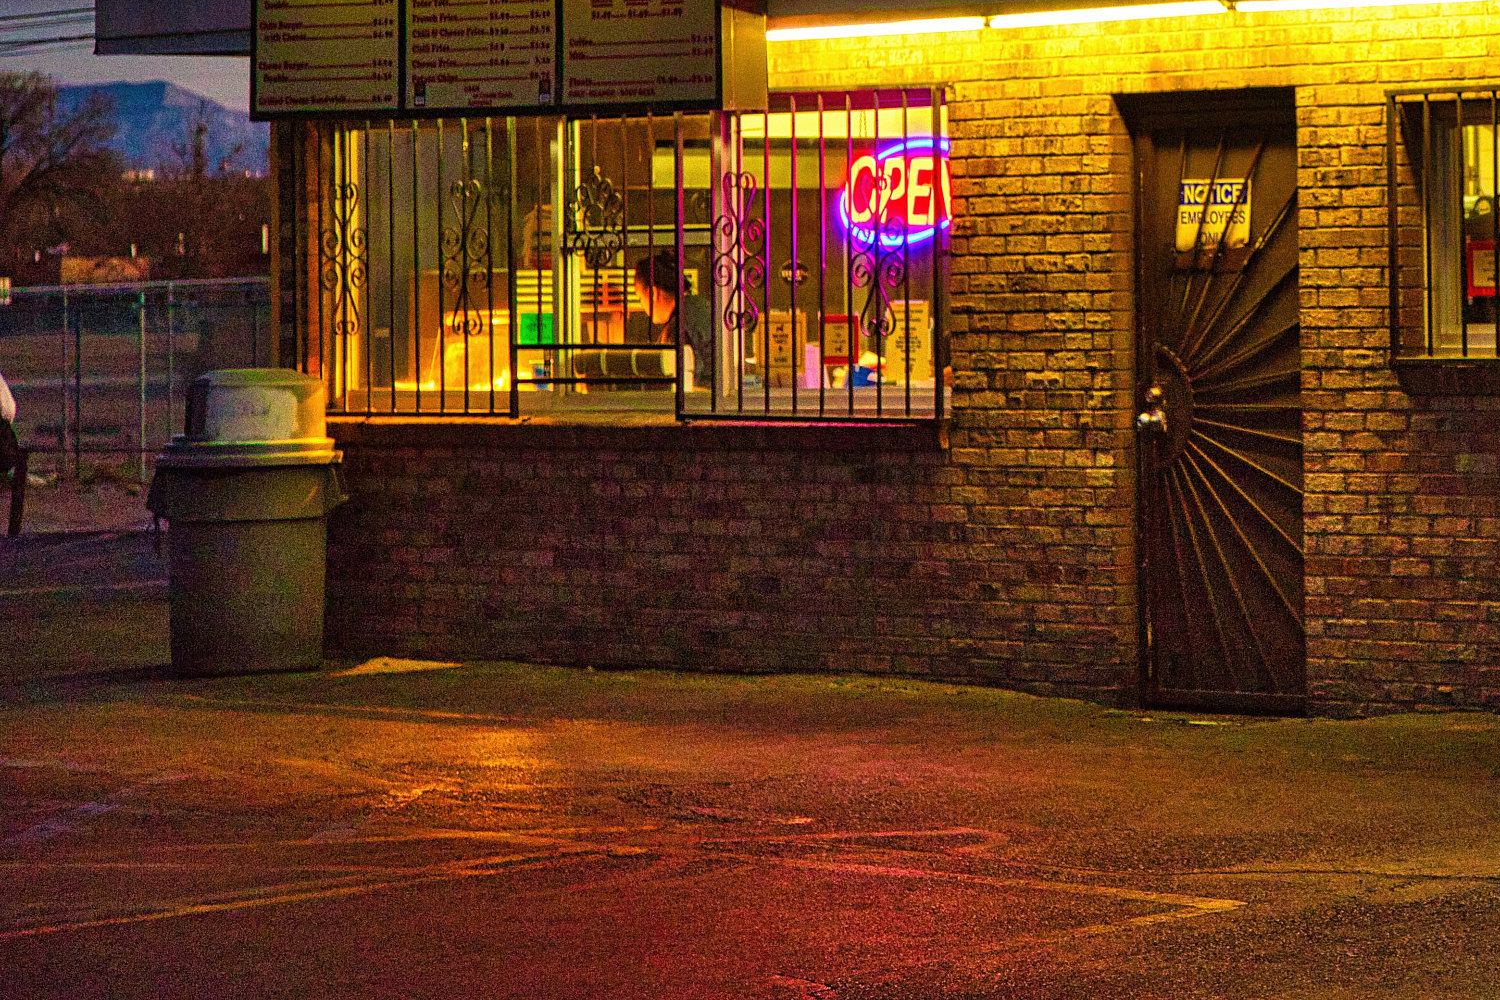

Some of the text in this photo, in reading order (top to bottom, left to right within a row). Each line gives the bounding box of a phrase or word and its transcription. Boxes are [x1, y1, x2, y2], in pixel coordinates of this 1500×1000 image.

[412, 14, 438, 23] French
[439, 13, 457, 22] Fries
[439, 28, 464, 37] Cheese
[1201, 231, 1224, 244] ONL
